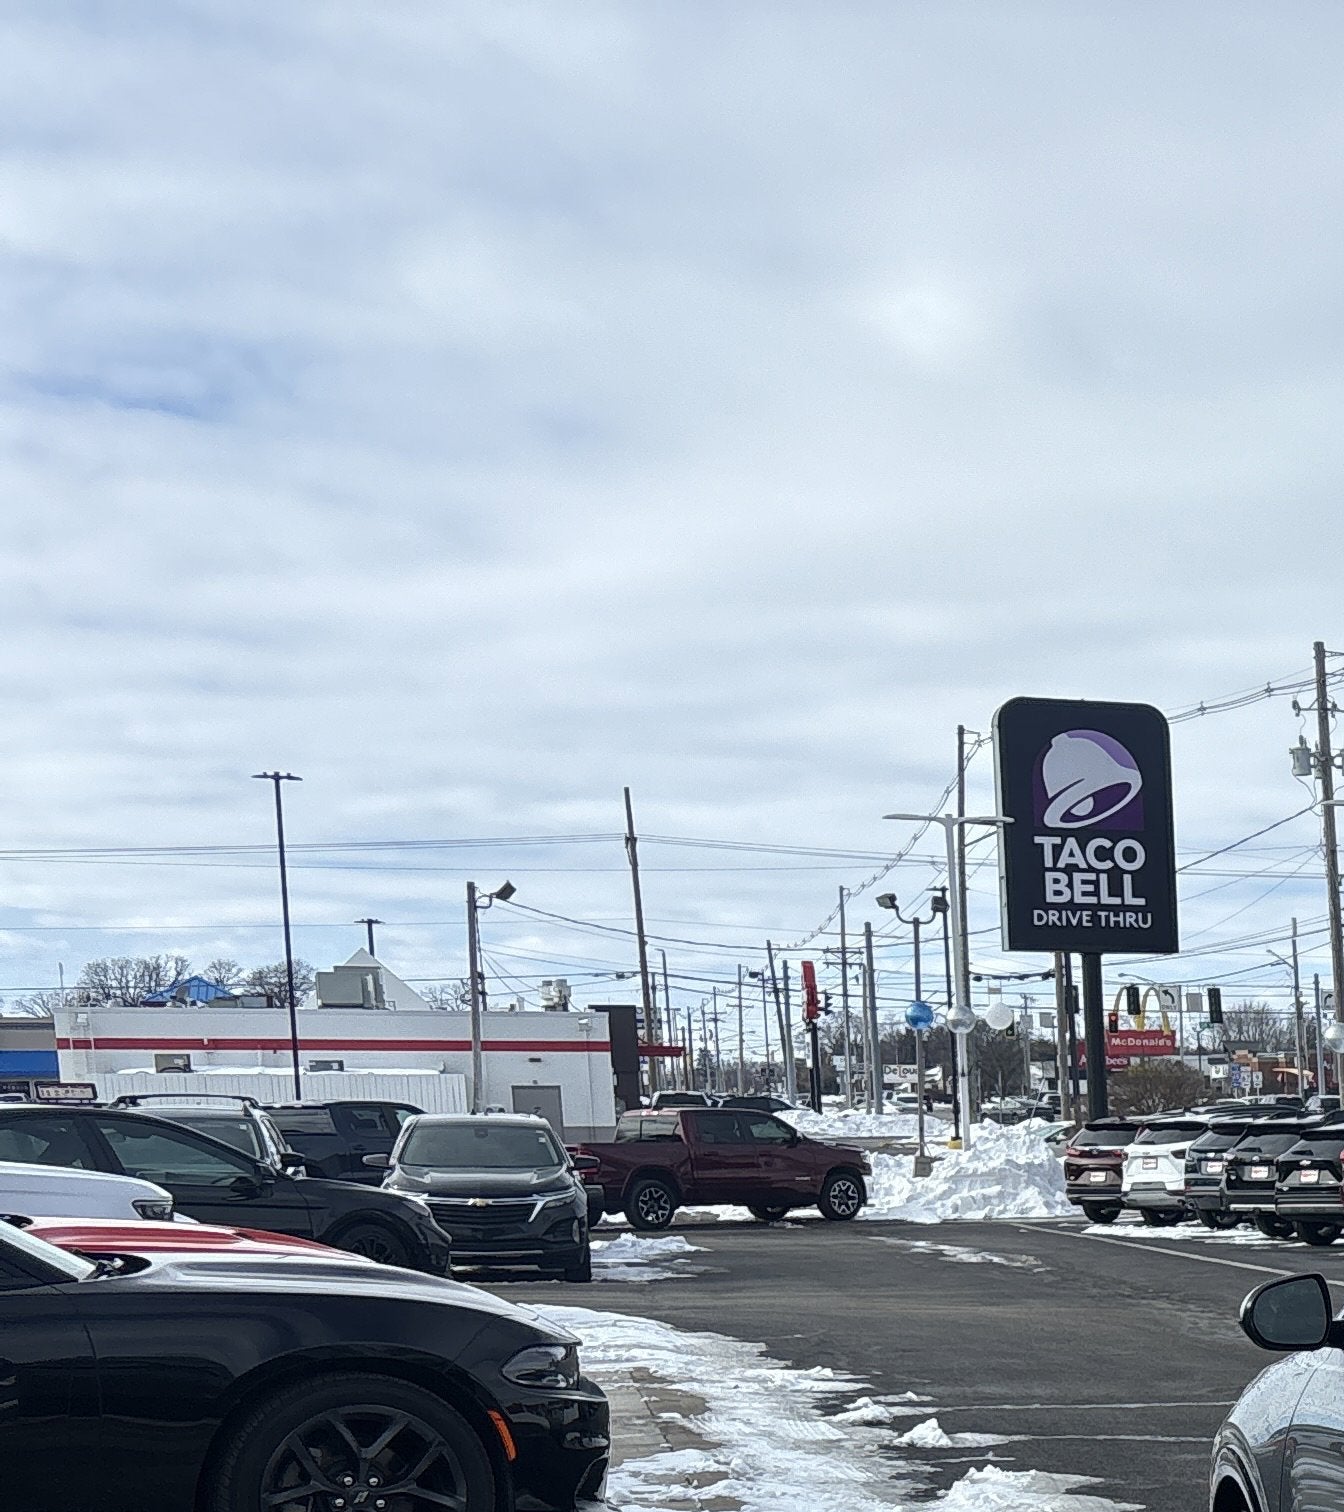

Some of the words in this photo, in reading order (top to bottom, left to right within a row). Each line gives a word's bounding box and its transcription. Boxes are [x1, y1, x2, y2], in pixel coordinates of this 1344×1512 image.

[1033, 836, 1146, 871] TACO
[1044, 872, 1146, 906] BELL
[1033, 909, 1093, 927] DRIVE
[1097, 911, 1152, 929] THRU
[1111, 1037, 1172, 1047] McDonald's
